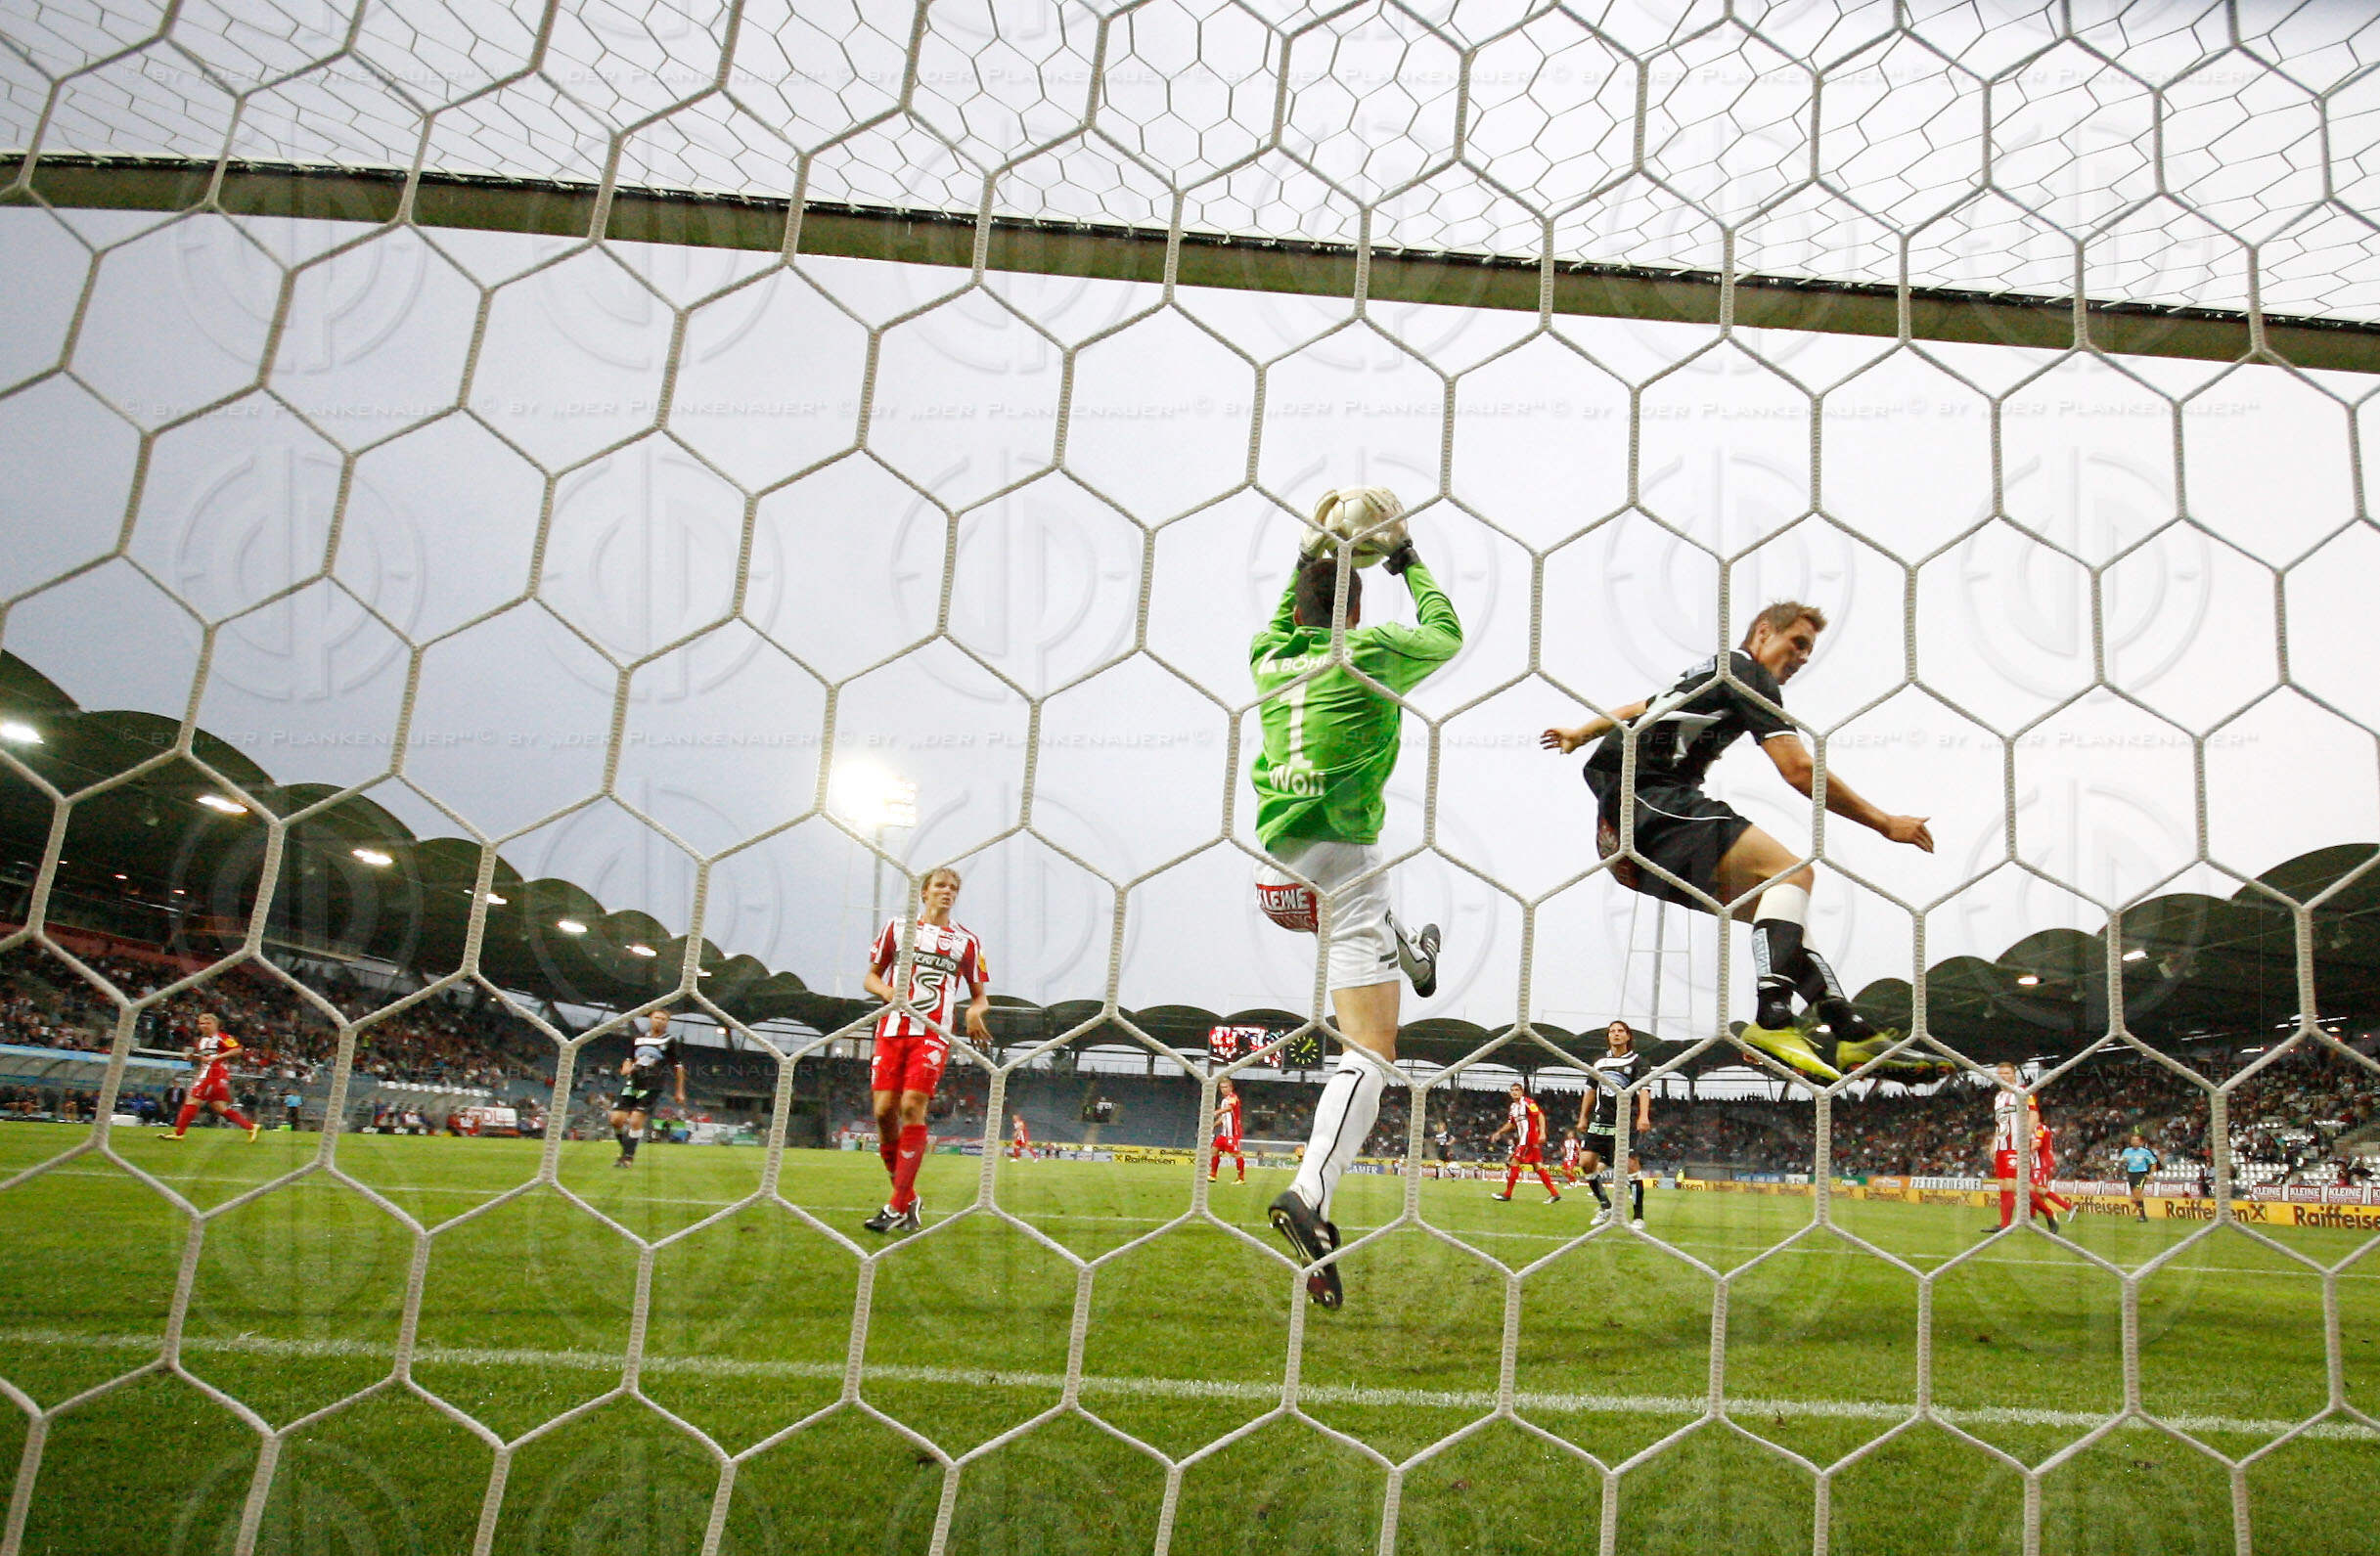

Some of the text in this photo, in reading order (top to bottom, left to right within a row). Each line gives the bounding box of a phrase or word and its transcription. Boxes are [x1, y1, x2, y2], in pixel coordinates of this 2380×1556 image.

[1280, 648, 1354, 673] BÖHR
[1279, 681, 1313, 769] 1
[2290, 1187, 2319, 1197] KLEINE
[2329, 1187, 2362, 1197] KLEINE
[2165, 1199, 2250, 1223] Raiffen
